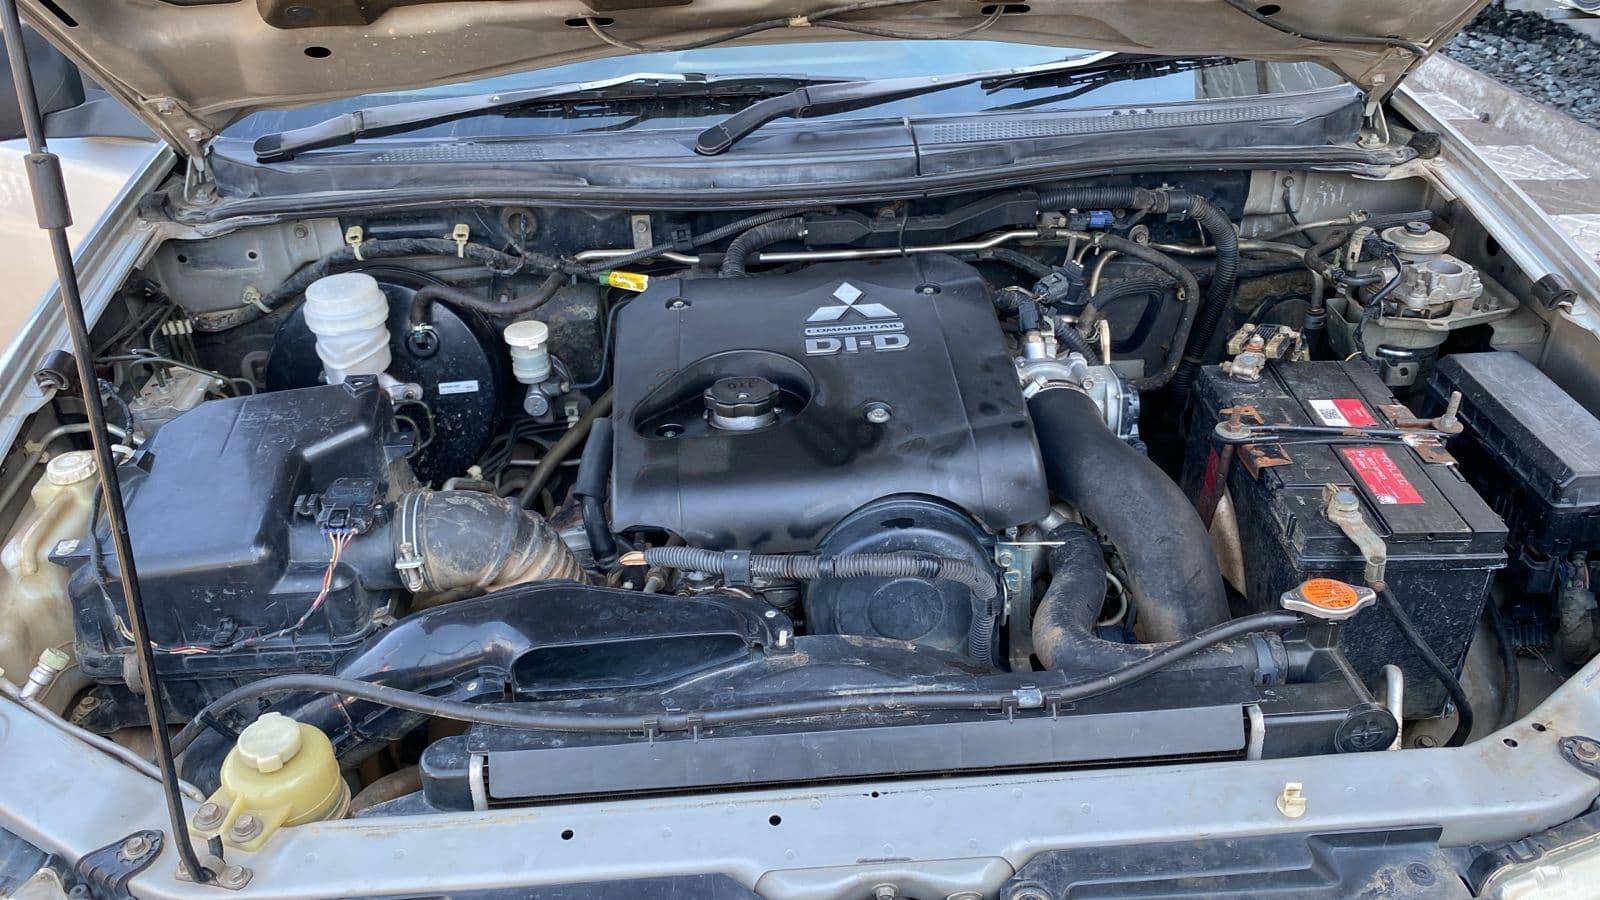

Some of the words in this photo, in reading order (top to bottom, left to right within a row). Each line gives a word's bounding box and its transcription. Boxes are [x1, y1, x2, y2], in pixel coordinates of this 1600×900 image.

[806, 324, 866, 334] COMMON
[869, 322, 903, 331] RAIL
[805, 333, 910, 355] DI-D
[727, 381, 754, 390] OIL
